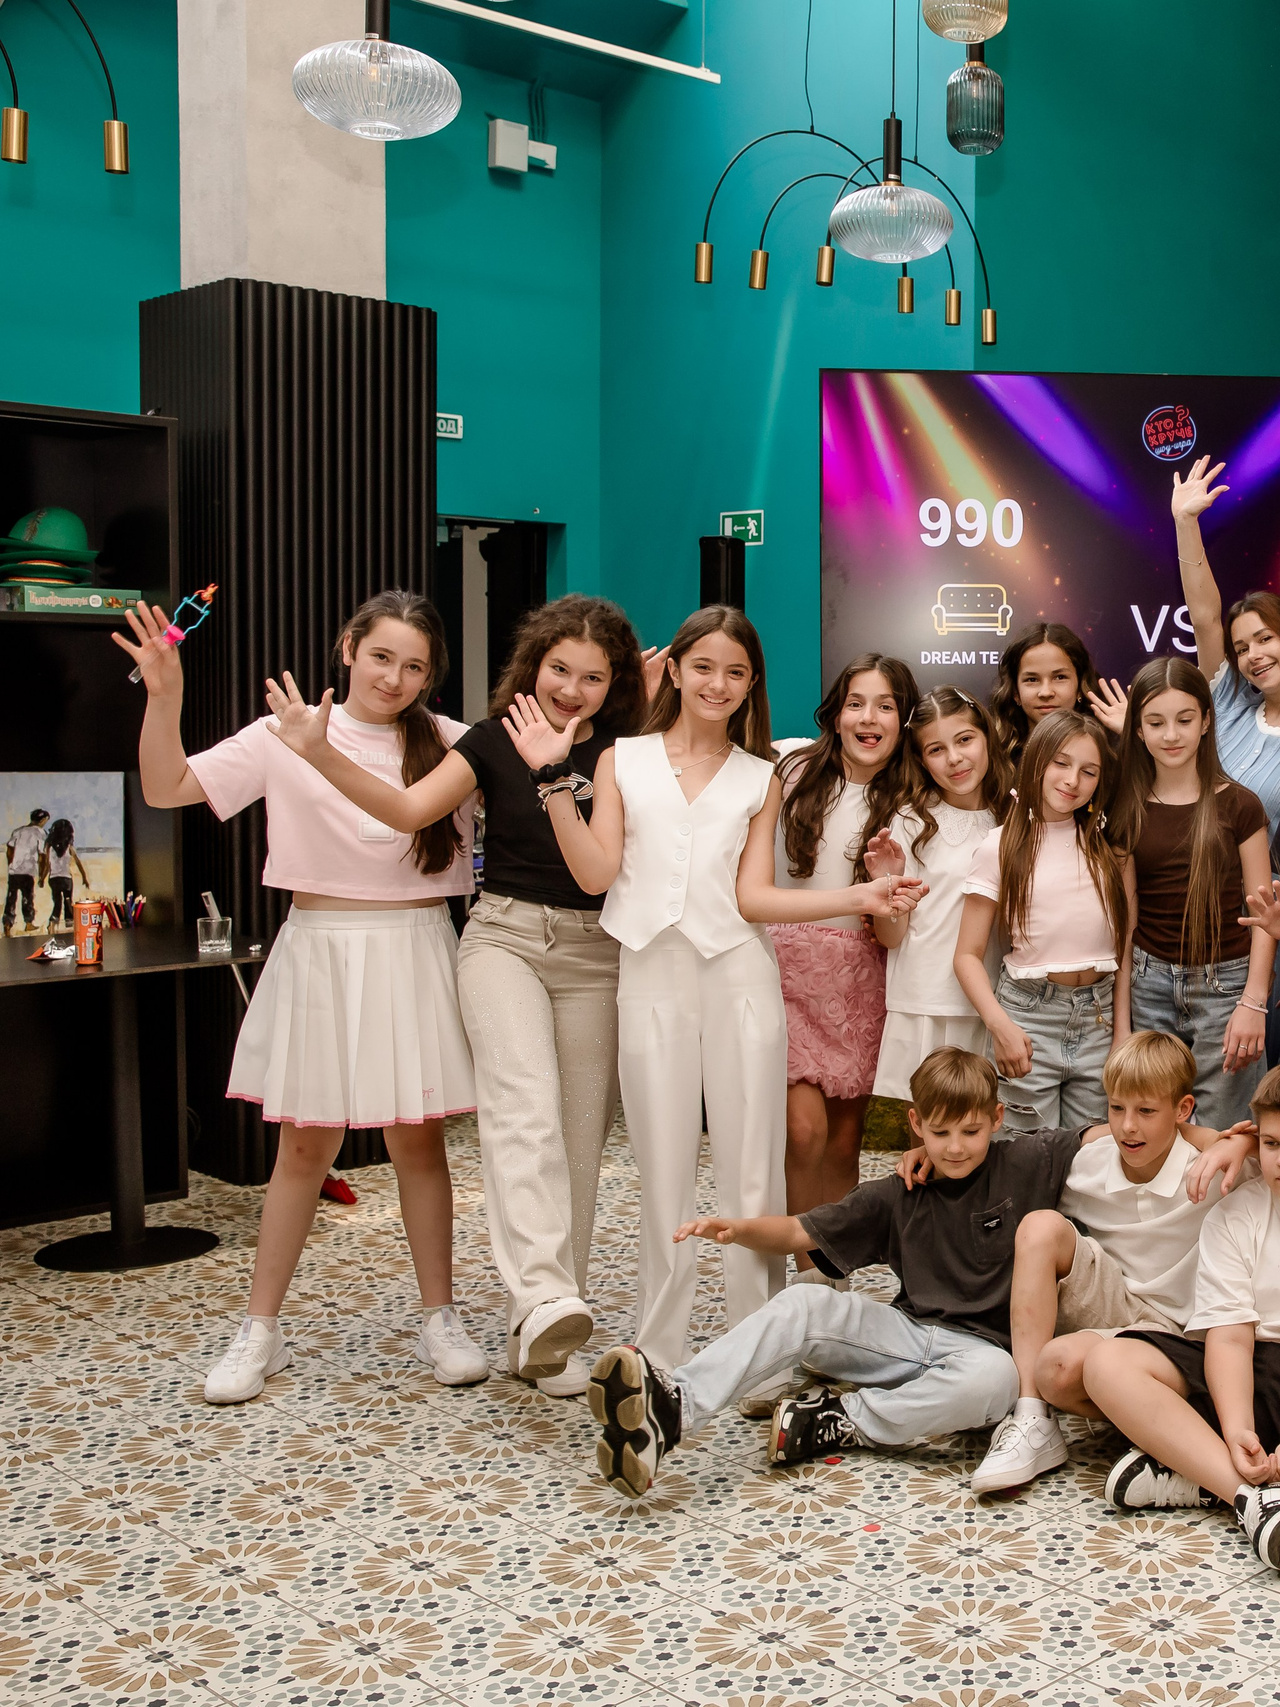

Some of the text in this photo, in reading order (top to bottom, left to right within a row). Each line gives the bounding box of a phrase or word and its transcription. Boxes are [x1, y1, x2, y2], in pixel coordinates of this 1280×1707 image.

[437, 418, 456, 433] ОД
[1145, 418, 1174, 435] КТО
[1148, 425, 1194, 447] КРУЧЕ
[919, 497, 1024, 547] 990
[1130, 604, 1199, 653] VS
[921, 651, 999, 665] DREAM TE
